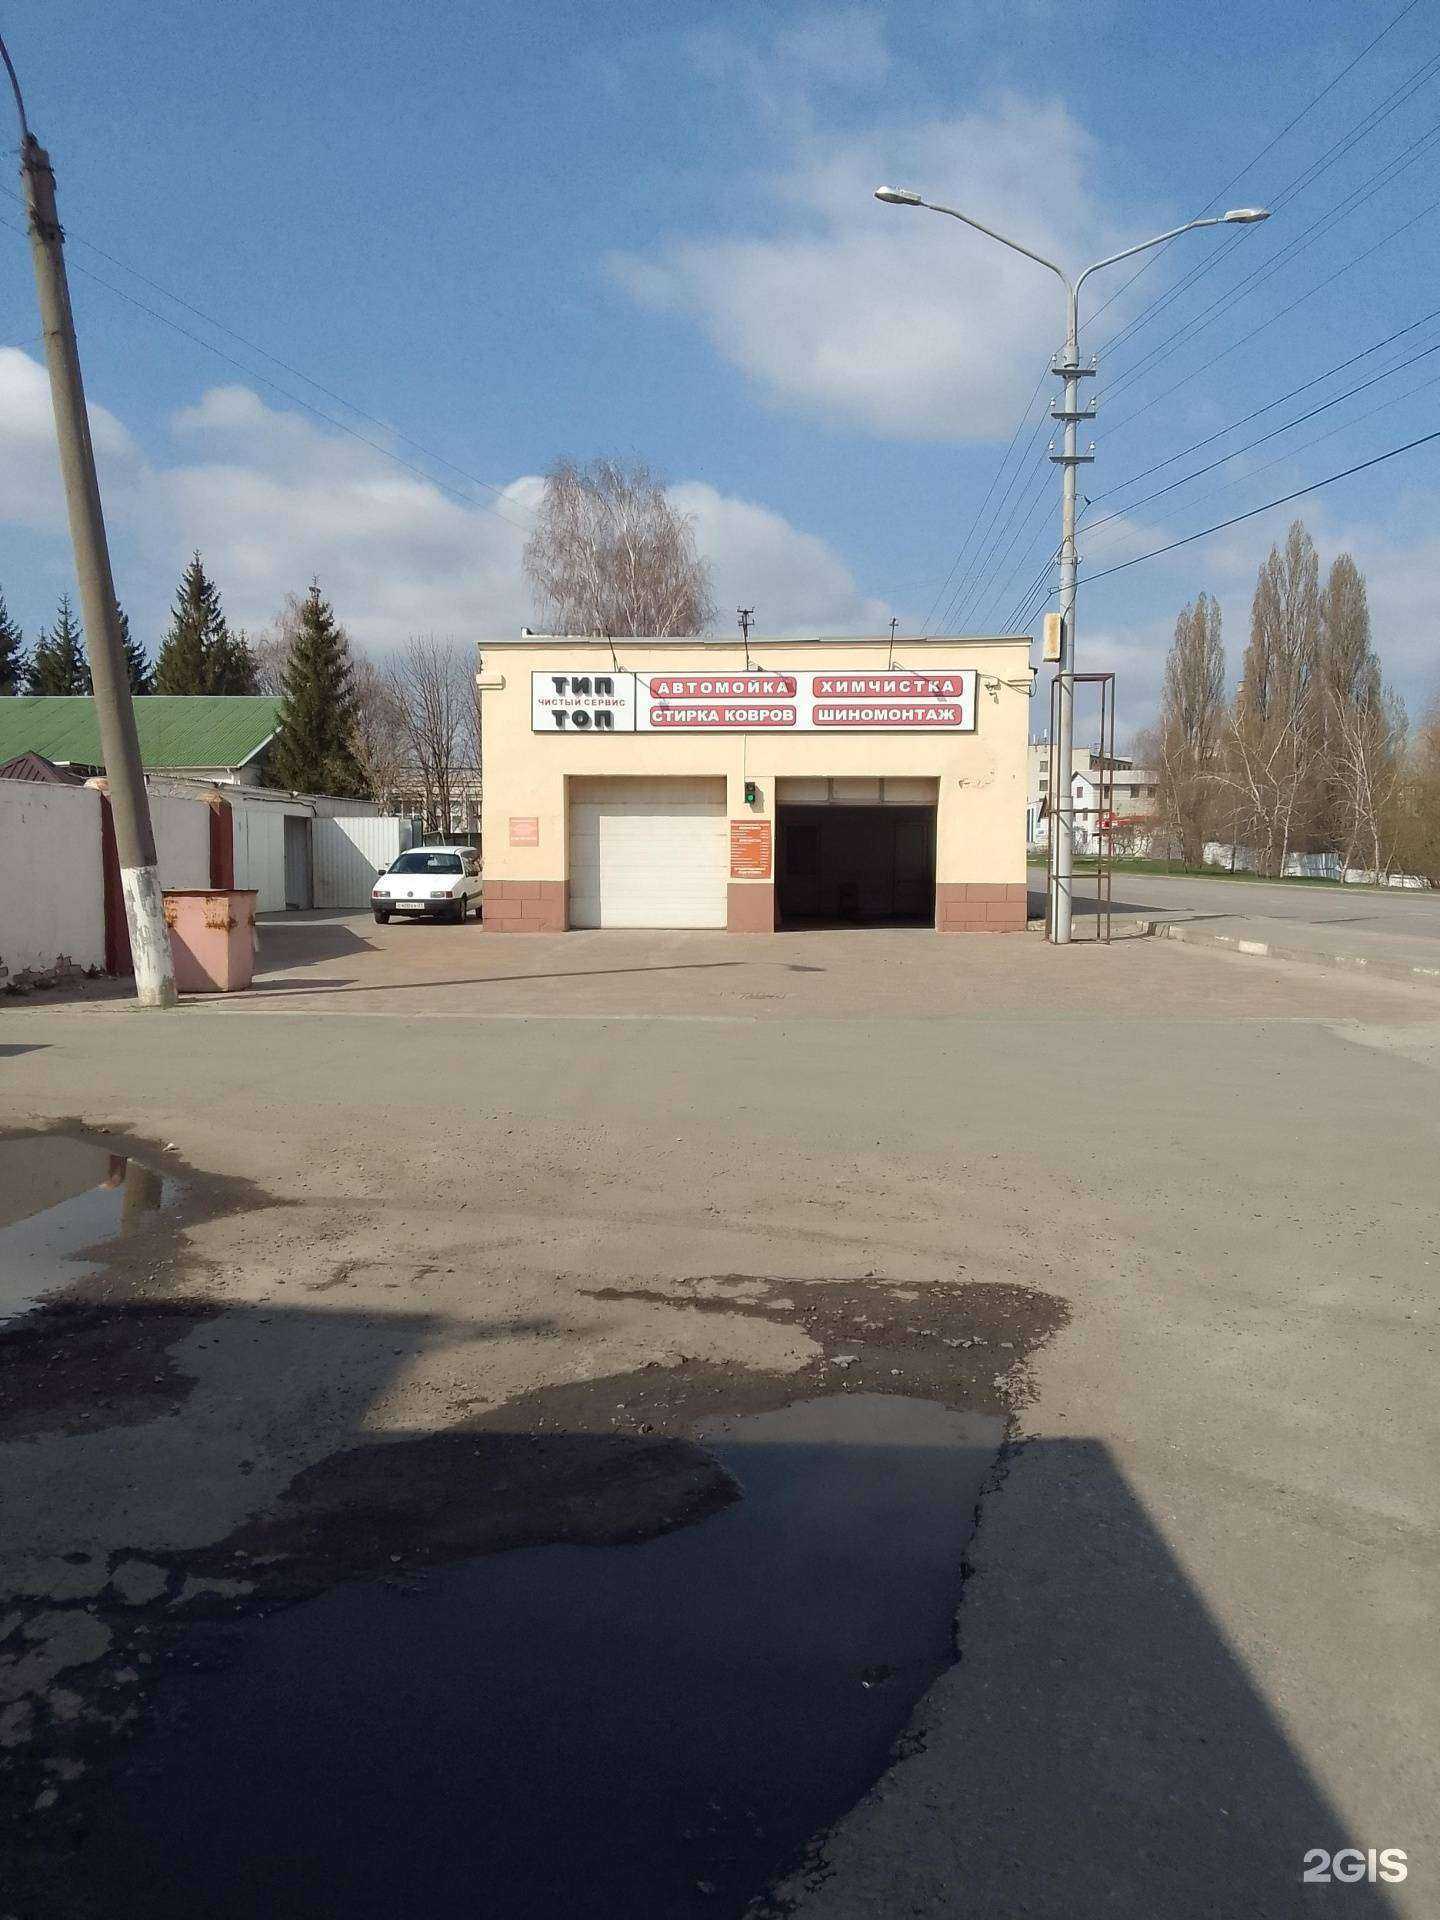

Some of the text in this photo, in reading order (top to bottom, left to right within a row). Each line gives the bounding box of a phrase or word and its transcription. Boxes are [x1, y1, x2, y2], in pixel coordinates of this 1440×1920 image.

[551, 676, 614, 697] ТИП
[657, 680, 789, 694] АВТОМОЙКА
[820, 680, 955, 693] ХИМЧИСТКА
[538, 698, 626, 707] ЧИСТЫЙ СЕРВИС
[551, 709, 614, 730] ТОП
[651, 709, 794, 722] СТИРКА КОВРОВ
[818, 709, 955, 721] ШИНОМОНТАЖ
